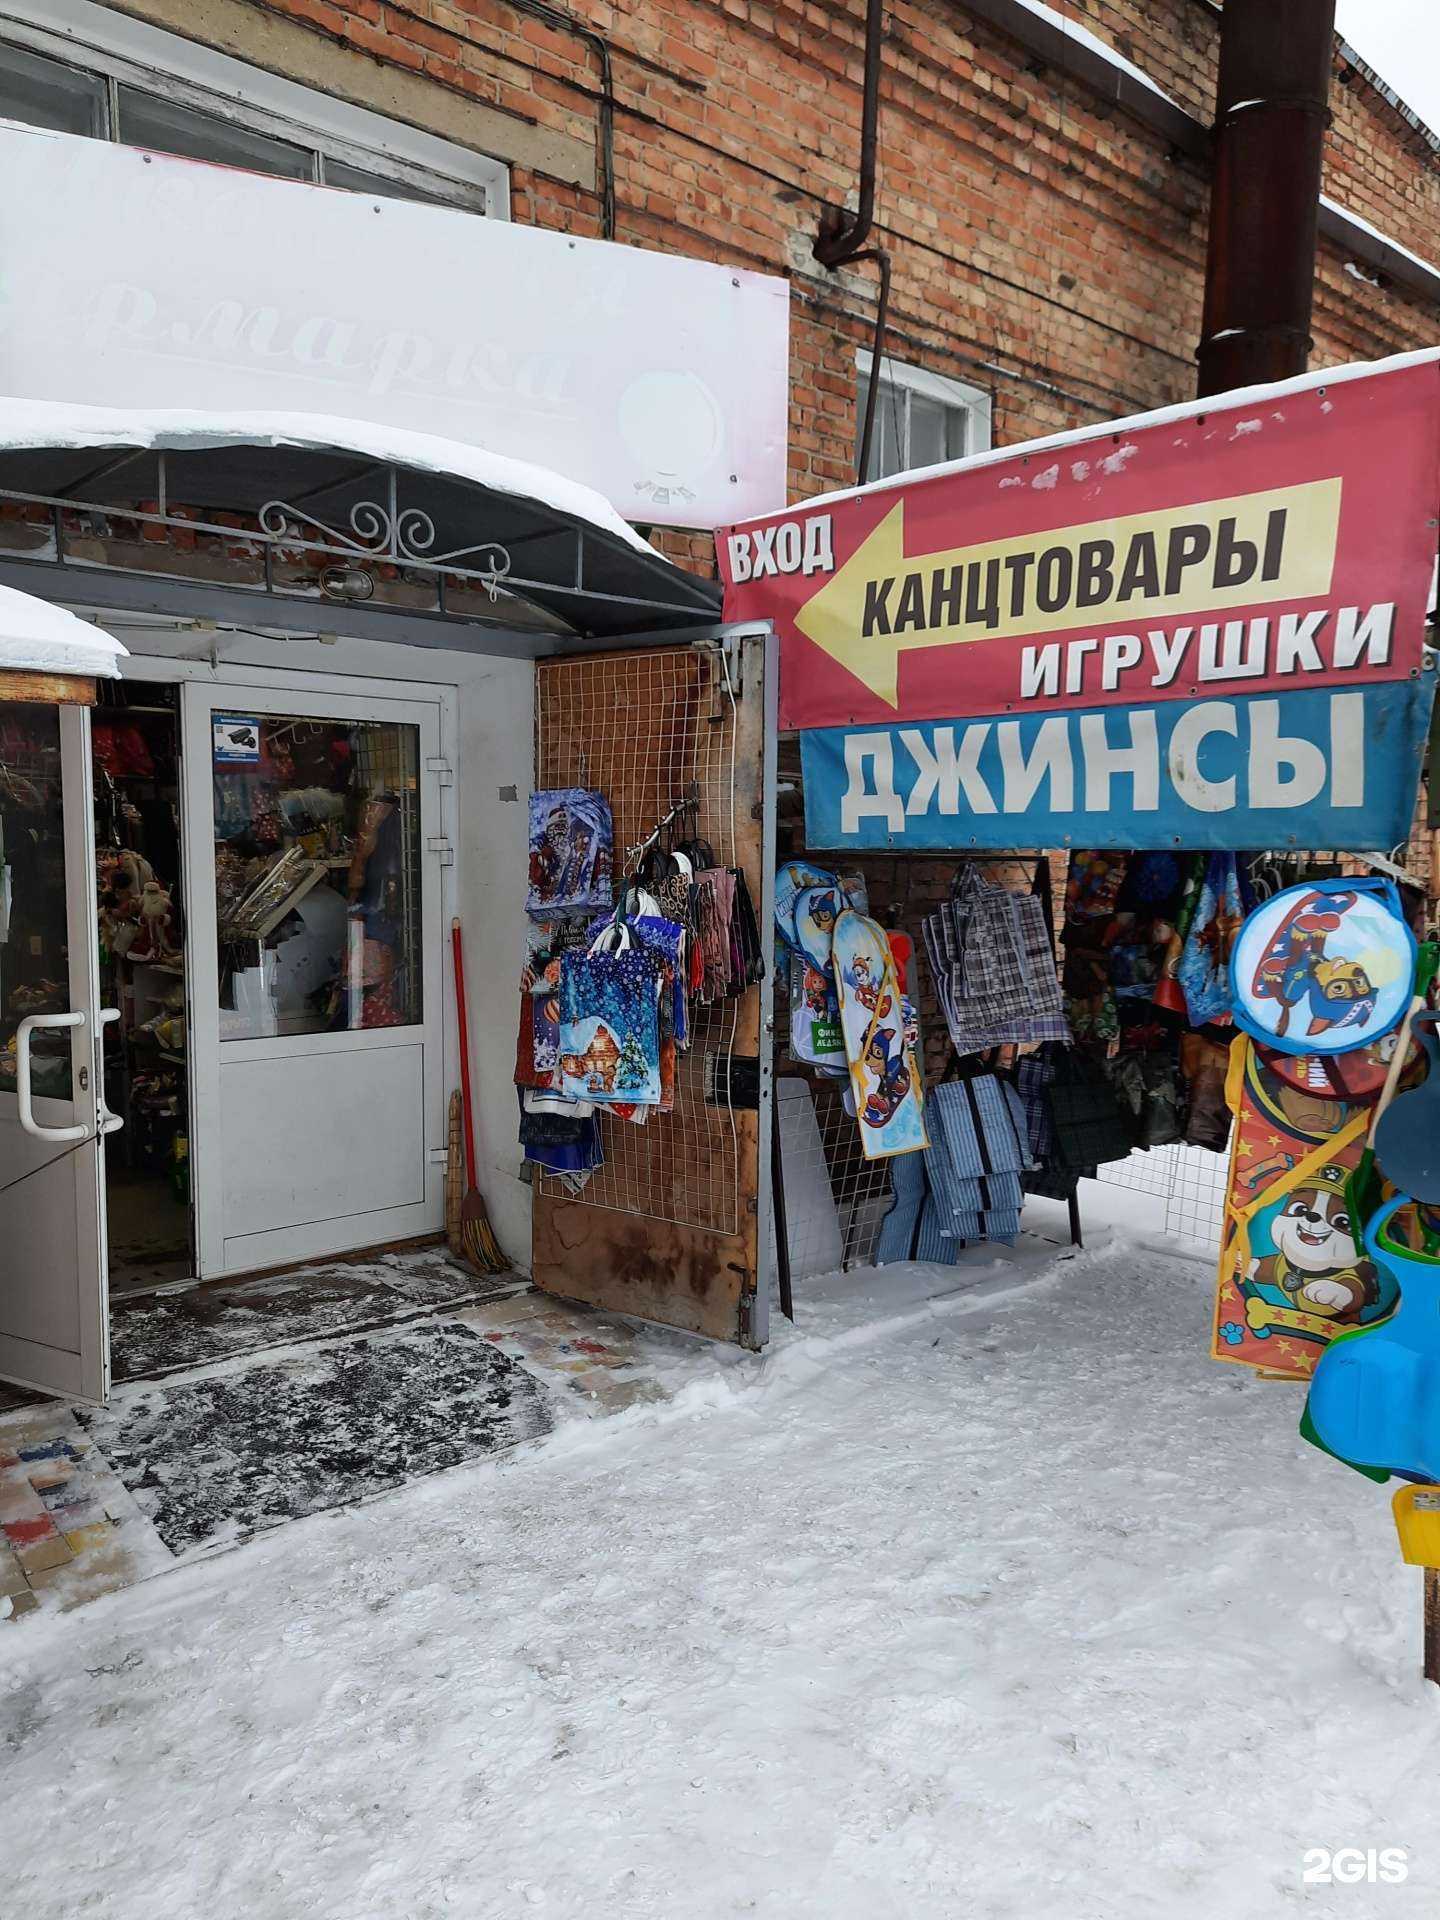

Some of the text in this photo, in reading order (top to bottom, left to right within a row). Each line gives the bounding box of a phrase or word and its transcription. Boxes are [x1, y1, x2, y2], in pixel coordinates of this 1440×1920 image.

[727, 515, 834, 584] ВХОД
[862, 509, 1287, 638] КАНЦТОВАРЫ
[1020, 602, 1395, 698] ИГРУШКИ
[841, 693, 1366, 833] ДЖИНСЫ
